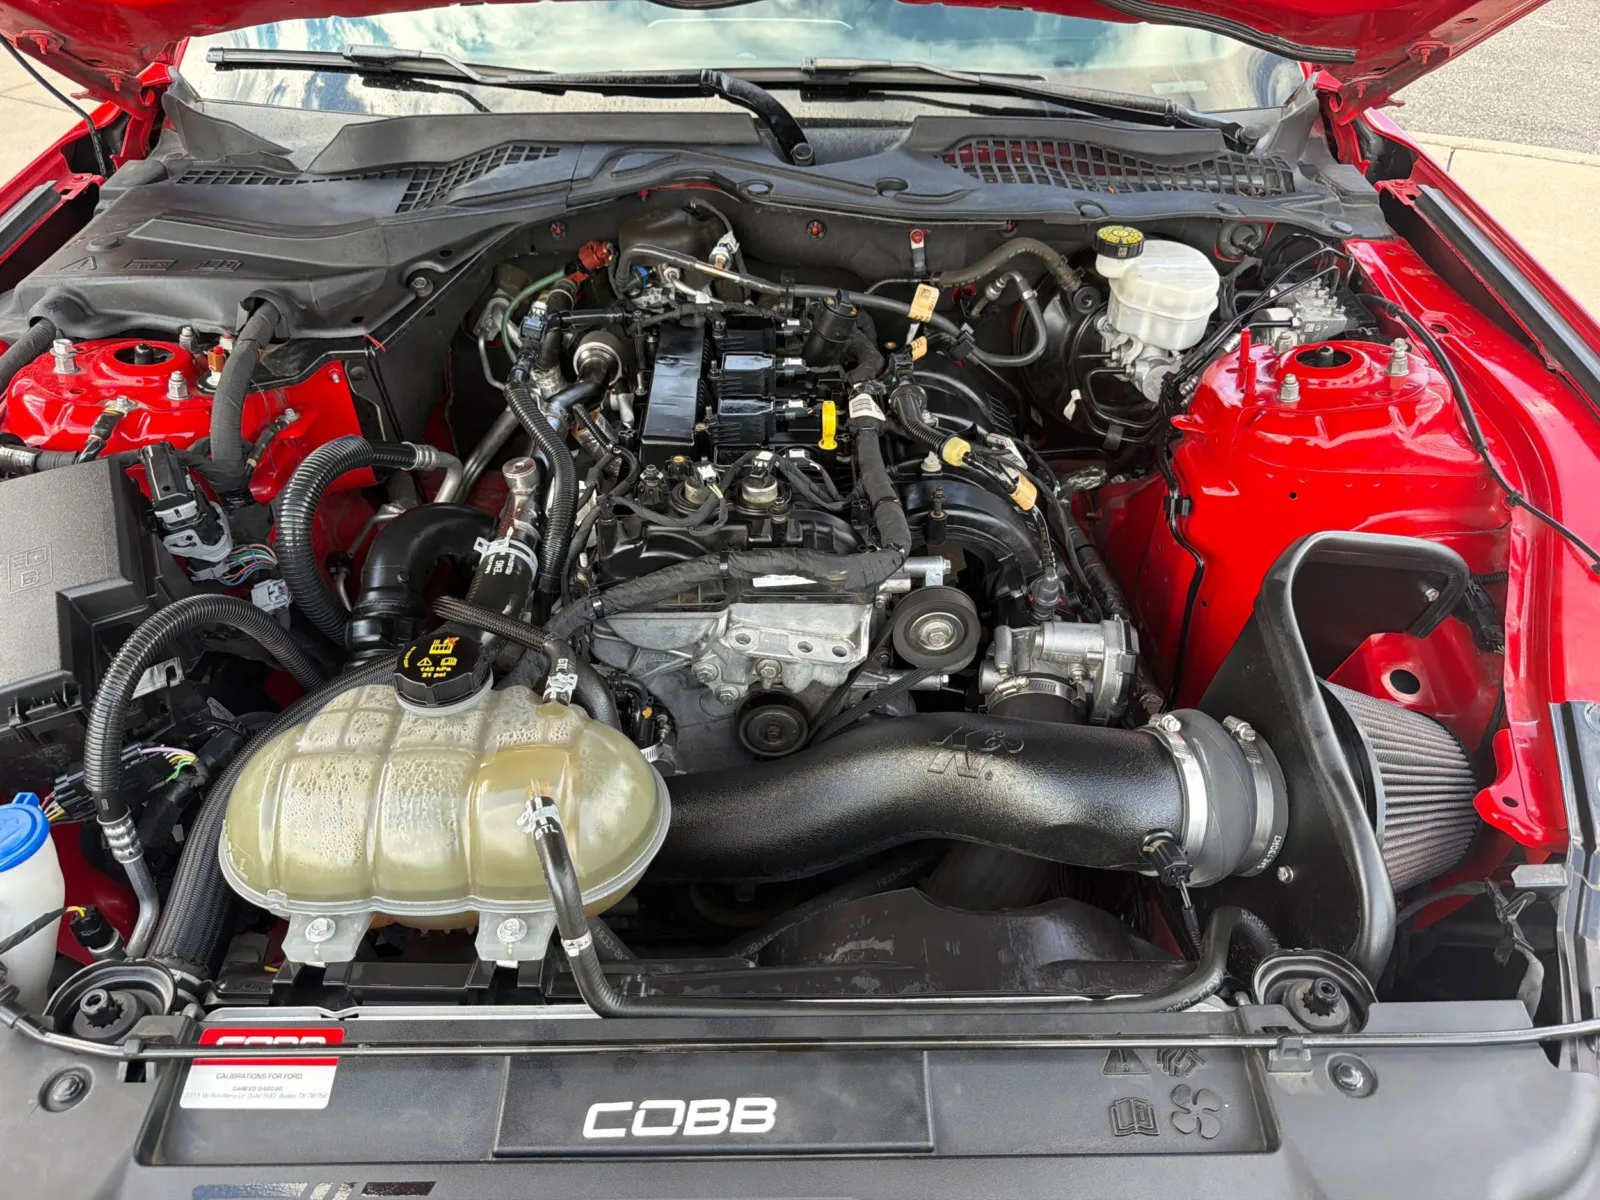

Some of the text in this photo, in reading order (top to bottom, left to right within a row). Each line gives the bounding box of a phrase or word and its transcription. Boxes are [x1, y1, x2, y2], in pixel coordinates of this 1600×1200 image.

[535, 824, 559, 840] BTL
[216, 1072, 303, 1080] CALIBRATIONS FOR FORD
[582, 1097, 777, 1139] COBB
